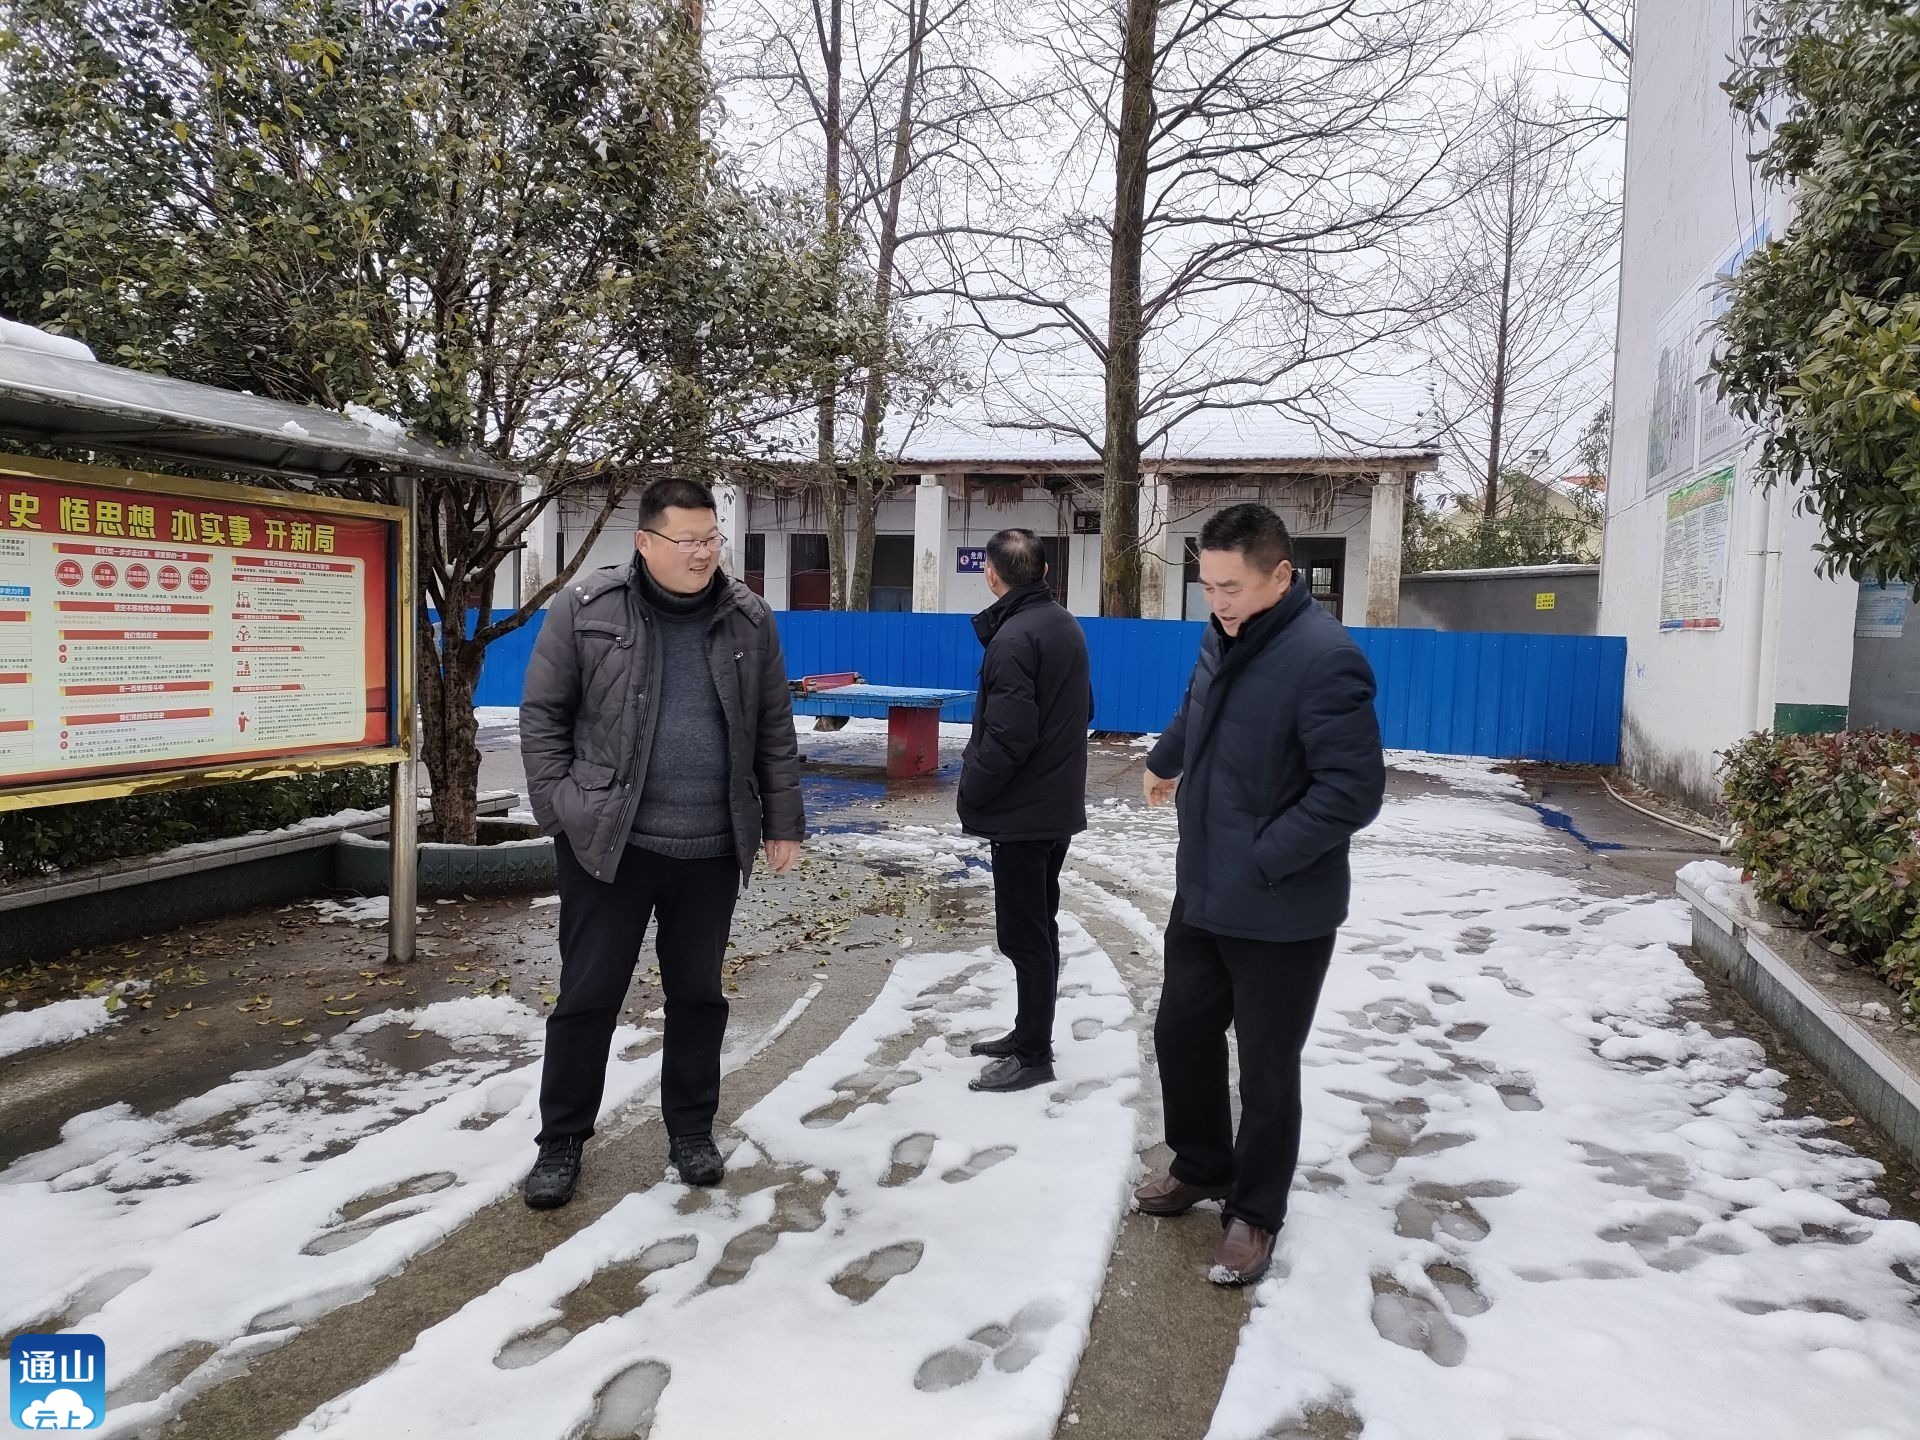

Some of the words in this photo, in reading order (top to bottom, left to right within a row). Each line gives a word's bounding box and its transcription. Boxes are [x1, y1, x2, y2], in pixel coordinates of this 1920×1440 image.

[0, 492, 42, 530] 史
[59, 496, 156, 539] 悟思想
[171, 509, 252, 546] 办实事
[264, 518, 335, 553] 开新局
